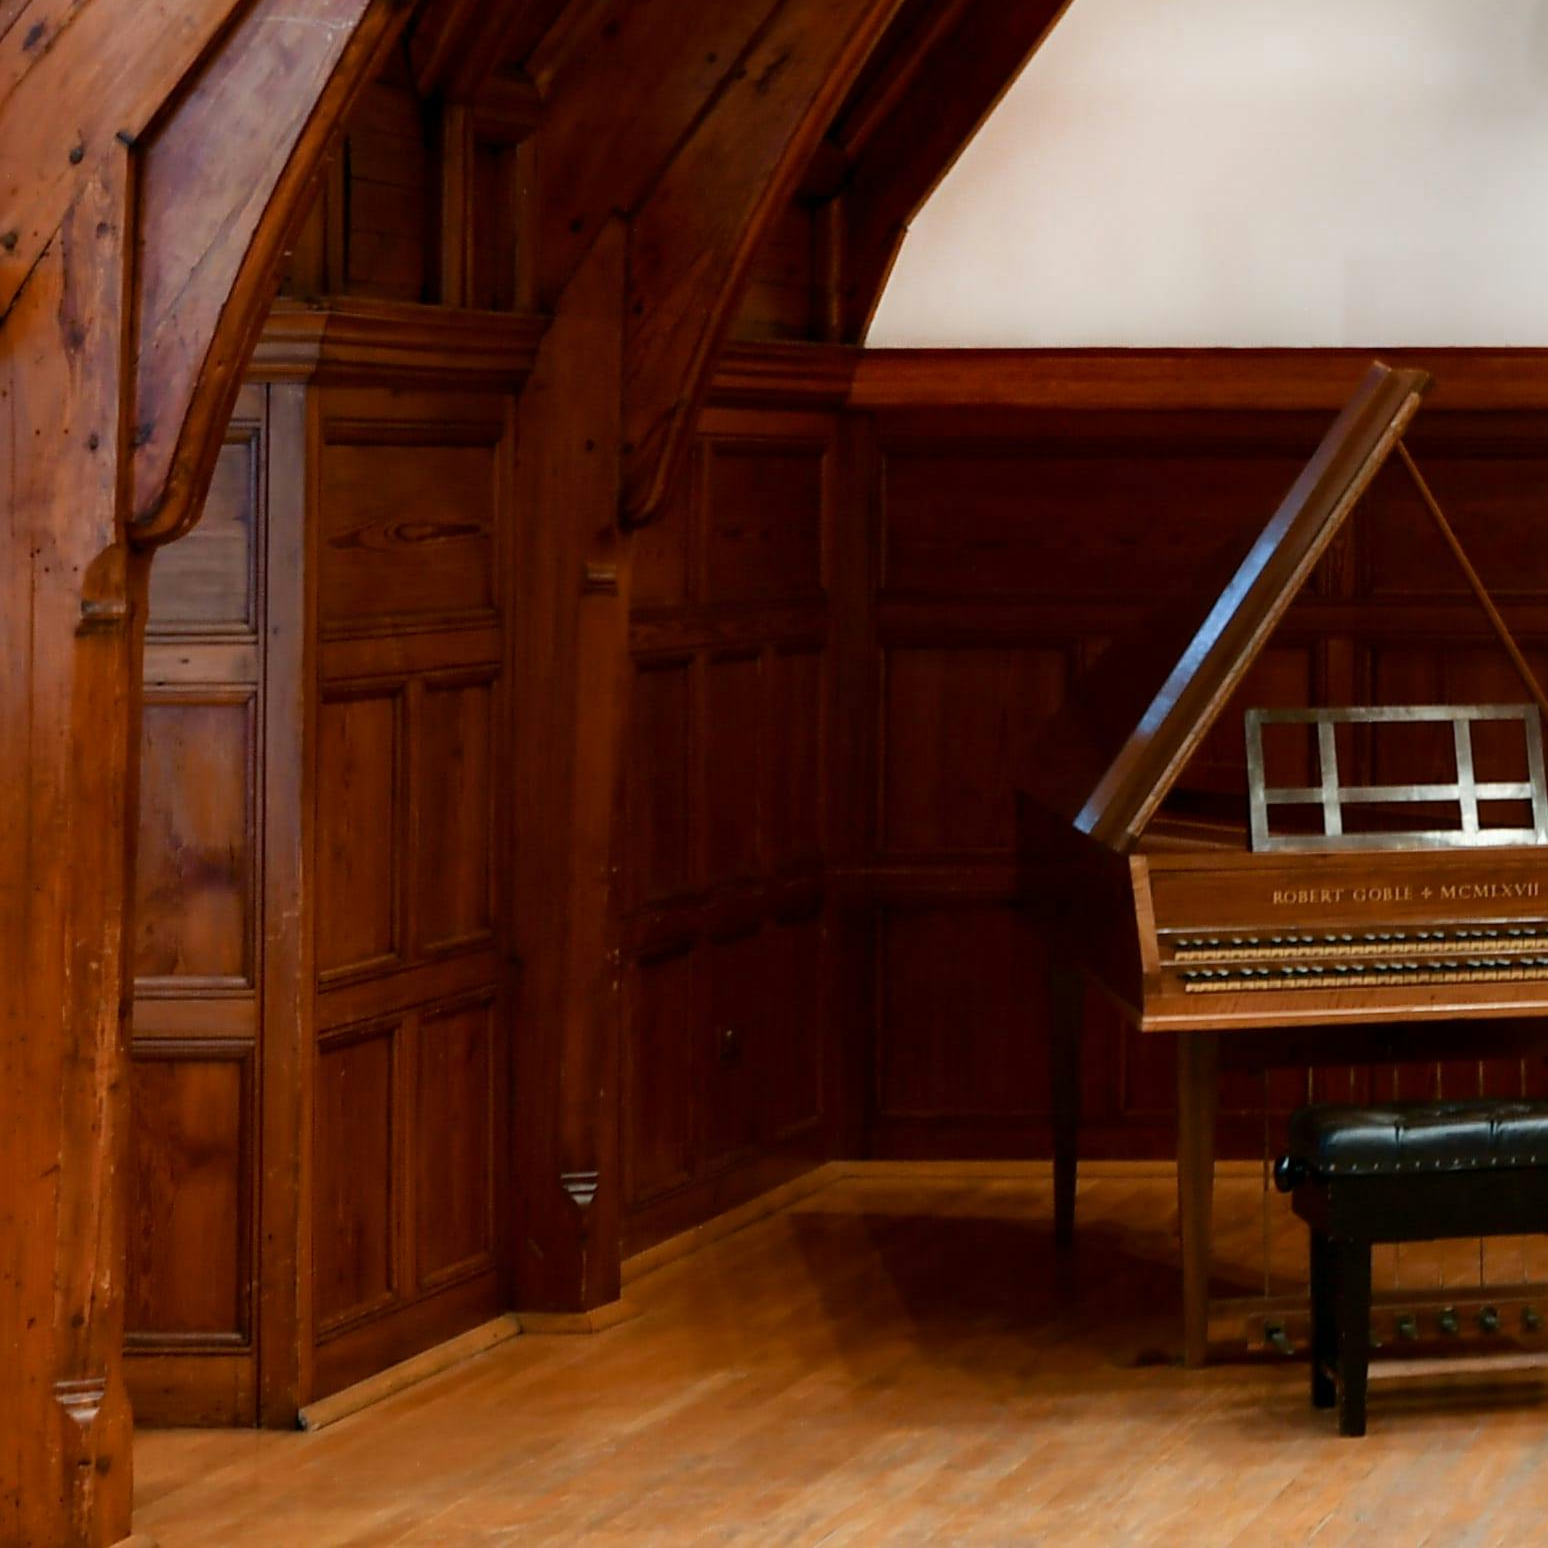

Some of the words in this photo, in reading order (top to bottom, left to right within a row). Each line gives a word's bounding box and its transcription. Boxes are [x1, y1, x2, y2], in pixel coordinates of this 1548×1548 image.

[1273, 888, 1344, 905] ROBERT
[1352, 886, 1412, 903] GOBLE
[1440, 882, 1540, 900] MCMLXVII
